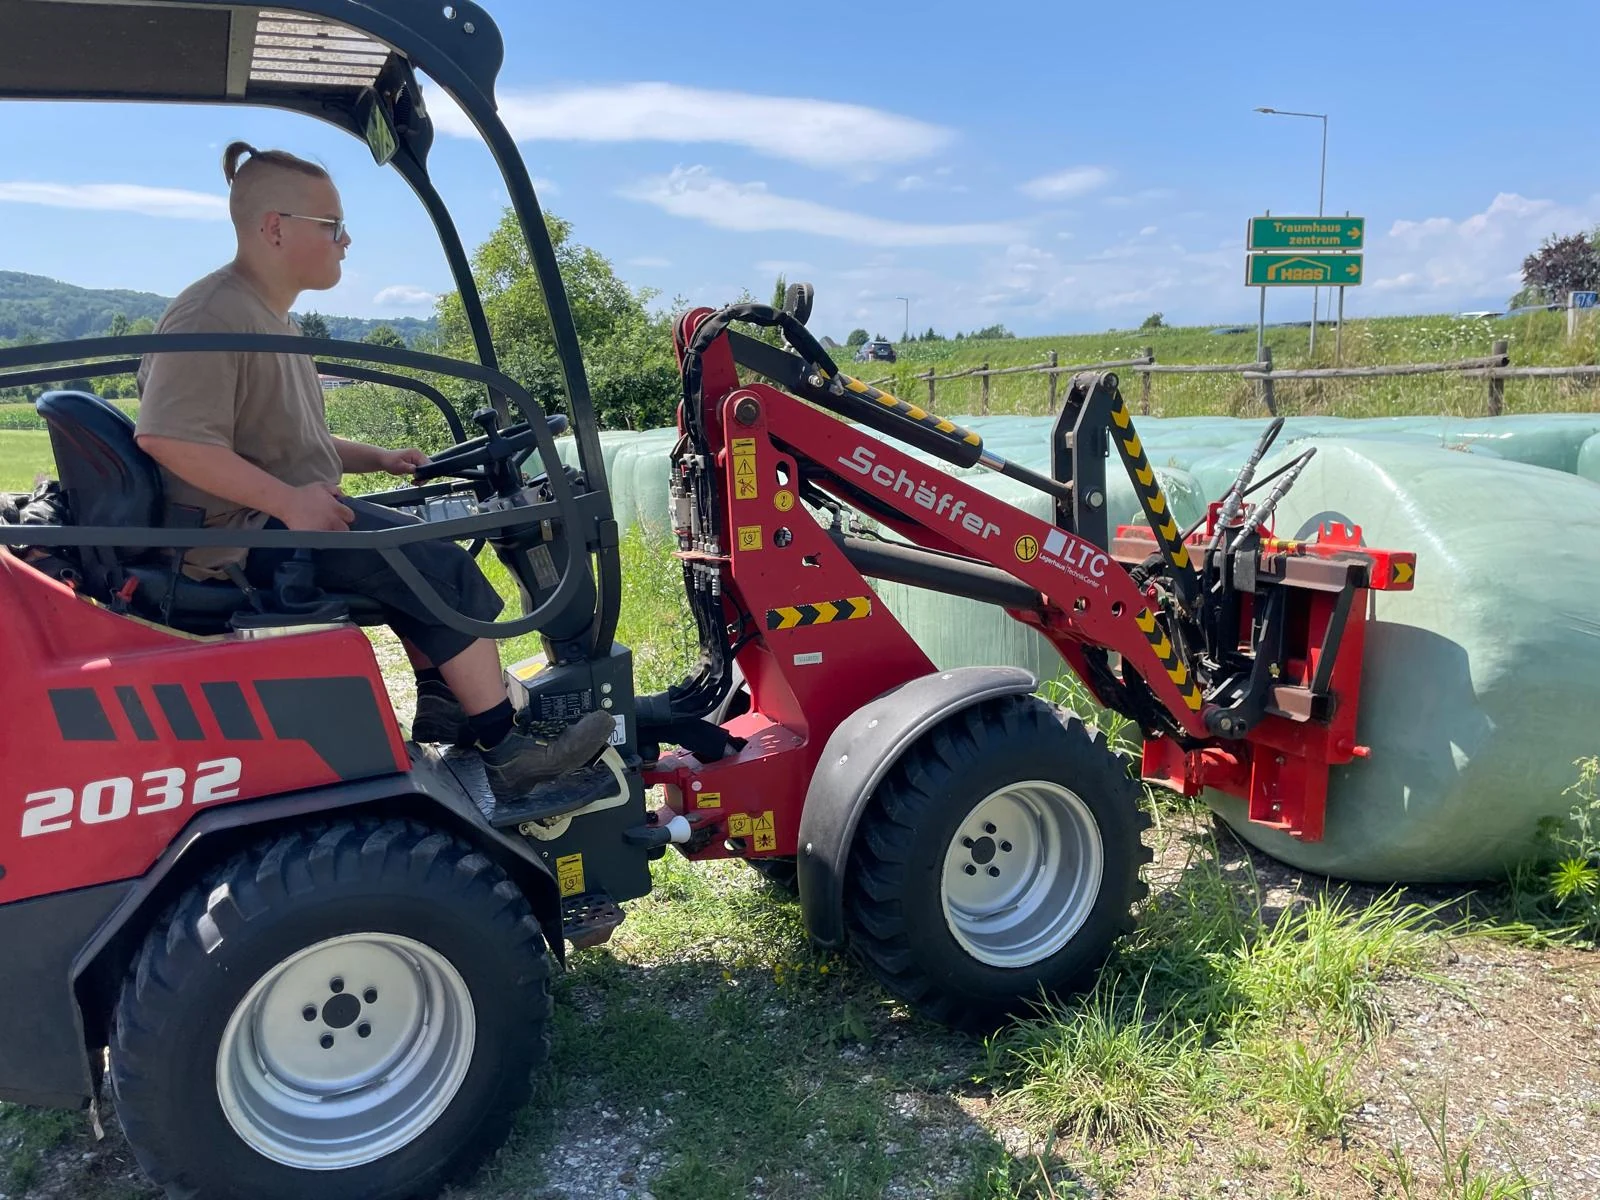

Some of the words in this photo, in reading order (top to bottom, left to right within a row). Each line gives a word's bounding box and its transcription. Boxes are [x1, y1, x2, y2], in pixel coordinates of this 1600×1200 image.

[1274, 222, 1341, 232] Traumhaus
[1289, 235, 1340, 245] zentrum
[838, 446, 1001, 540] Schäffer
[1063, 539, 1109, 577] LTC
[20, 757, 242, 838] 2032
